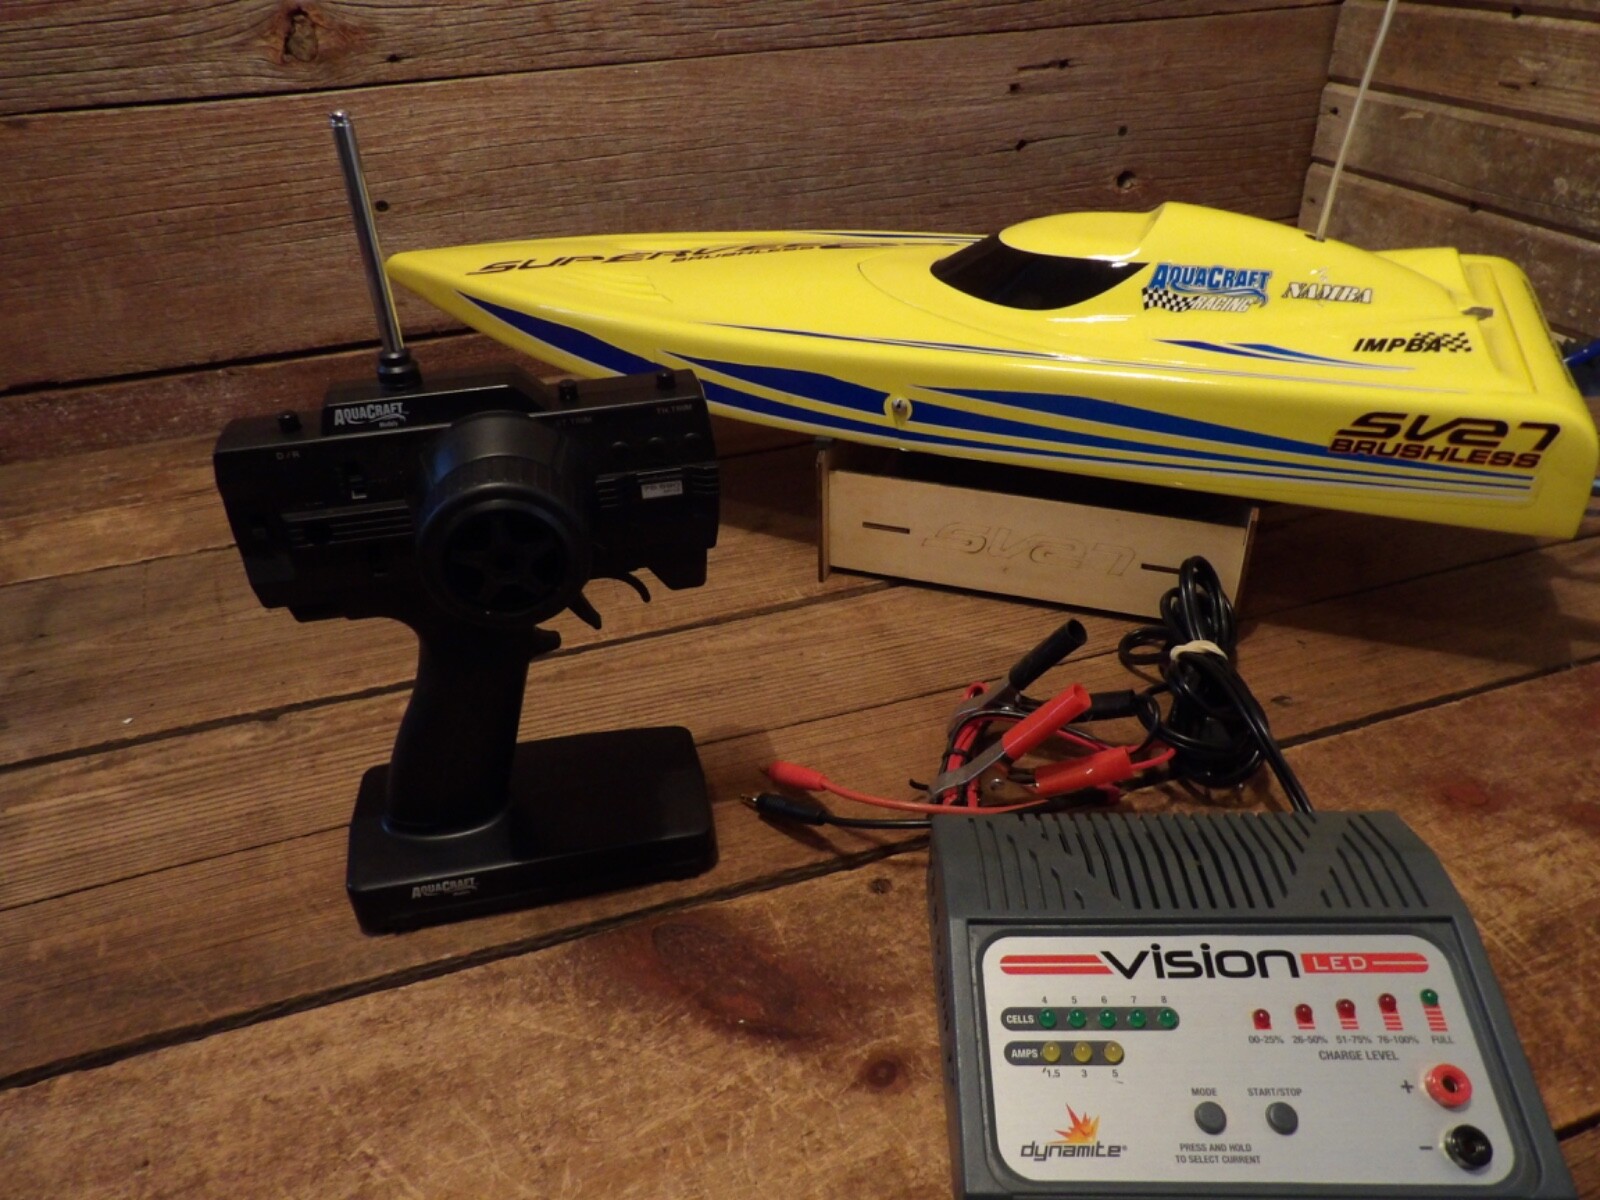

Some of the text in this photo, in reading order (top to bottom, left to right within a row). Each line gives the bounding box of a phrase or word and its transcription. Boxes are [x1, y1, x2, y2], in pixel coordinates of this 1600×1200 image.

[1148, 263, 1271, 292] AQUACRAFT
[1281, 281, 1373, 304] NAMBA
[1191, 296, 1252, 312] RACING
[1353, 337, 1442, 352] IMPBA
[334, 402, 404, 426] AQUACRAFT
[1335, 411, 1561, 452] SV27
[1327, 438, 1541, 469] BRUSHLESS
[922, 521, 1136, 577] SV27
[411, 876, 475, 899] AQUACRAFT
[1312, 956, 1367, 971] LED
[1041, 995, 1167, 1004] 4 5 6 7 8
[1006, 1014, 1034, 1025] CELLS
[1336, 1035, 1372, 1044] 51-75%
[1431, 1035, 1454, 1045] FULL
[1011, 1048, 1038, 1059] AMPS
[1318, 1050, 1399, 1061] CHARGE LEVEL
[1081, 1069, 1087, 1078] 3
[1112, 1069, 1118, 1078] 5
[1191, 1087, 1217, 1096] MODE
[1247, 1087, 1302, 1097] START/STOP
[1180, 1143, 1252, 1153] PRESS AND HOLD
[1175, 1154, 1260, 1164] TO SELECT CURRENT
